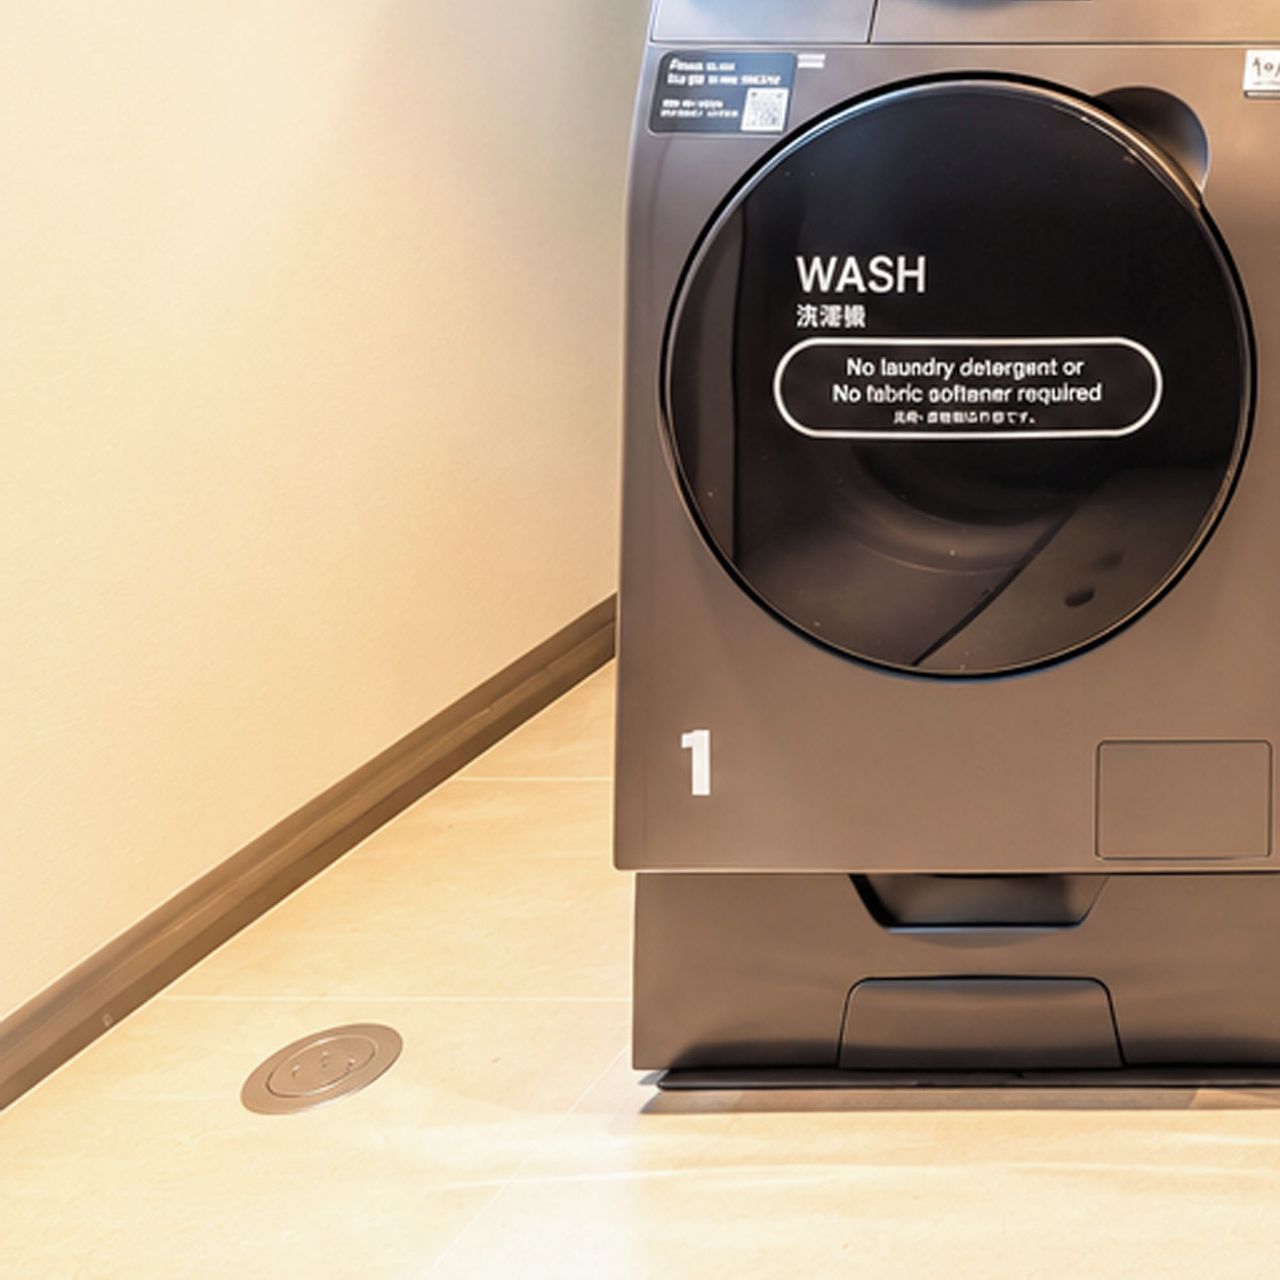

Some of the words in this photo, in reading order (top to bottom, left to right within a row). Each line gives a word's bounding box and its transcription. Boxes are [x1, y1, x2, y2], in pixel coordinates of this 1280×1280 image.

[797, 256, 925, 292] WASH
[847, 358, 875, 376] No
[881, 358, 955, 380] laundry
[960, 358, 1057, 380] detergent
[1063, 362, 1084, 375] or
[833, 384, 861, 402] No
[867, 384, 922, 402] fabric
[929, 384, 1012, 403] softener
[1018, 383, 1101, 405] required
[682, 730, 710, 795] 1
